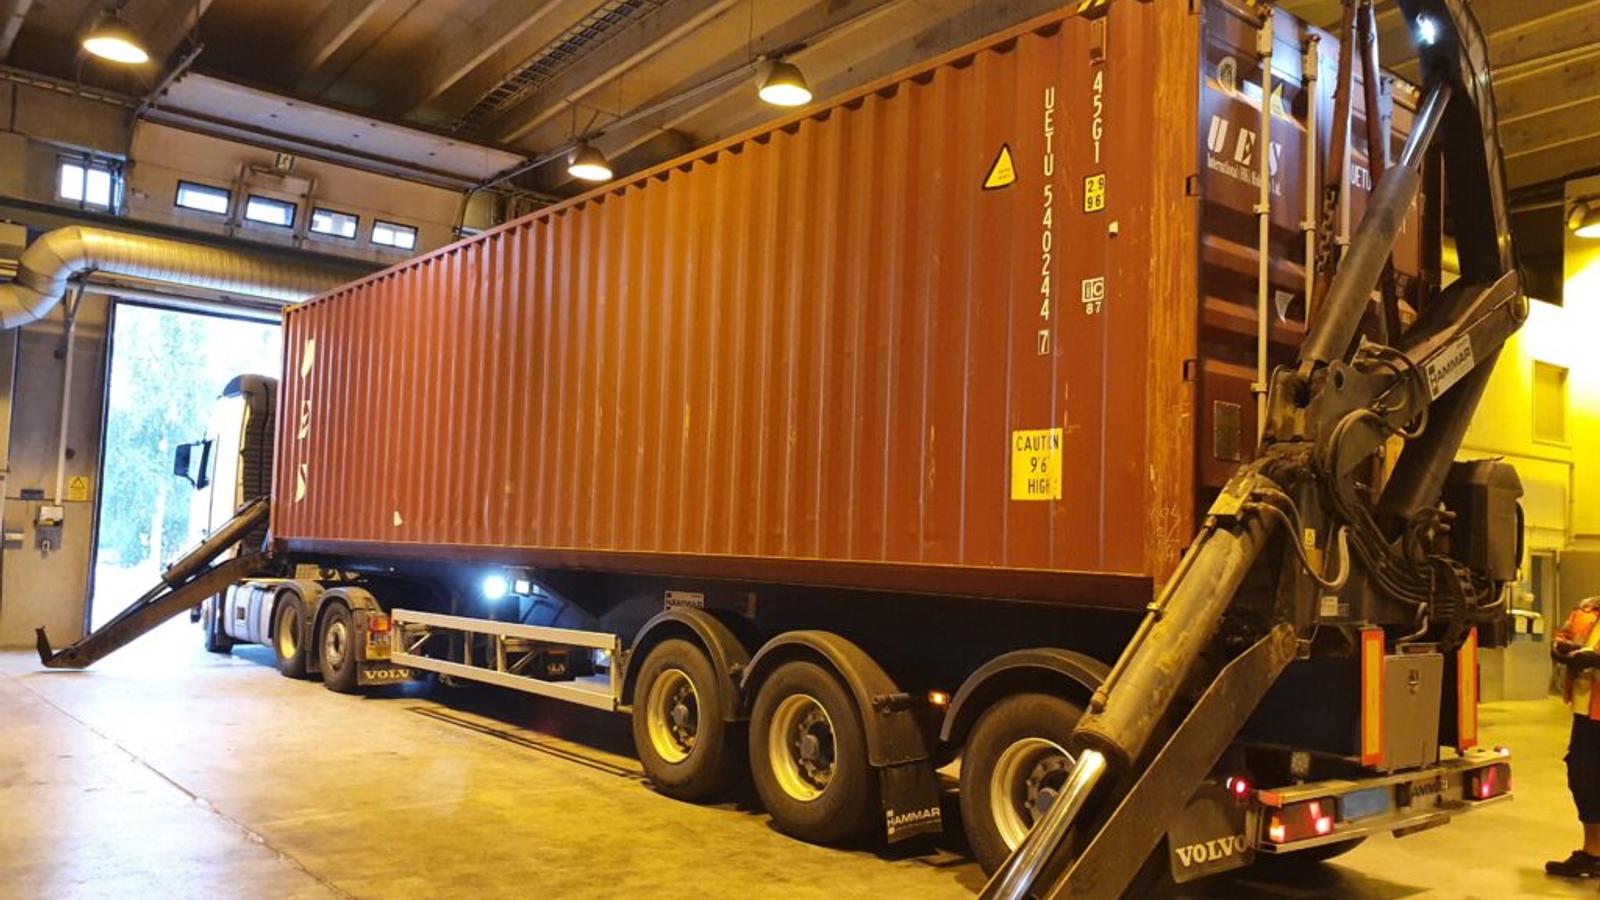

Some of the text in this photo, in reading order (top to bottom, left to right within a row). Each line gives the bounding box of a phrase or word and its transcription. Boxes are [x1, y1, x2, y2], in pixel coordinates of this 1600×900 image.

[1092, 71, 1103, 163] 45G1
[1039, 86, 1055, 355] UETU 540244 7
[1085, 301, 1102, 315] 87
[1429, 346, 1472, 387] HAMMAR
[363, 669, 411, 680] VOLV
[887, 807, 940, 828] HAMMAR
[1175, 835, 1247, 867] VOLVO
